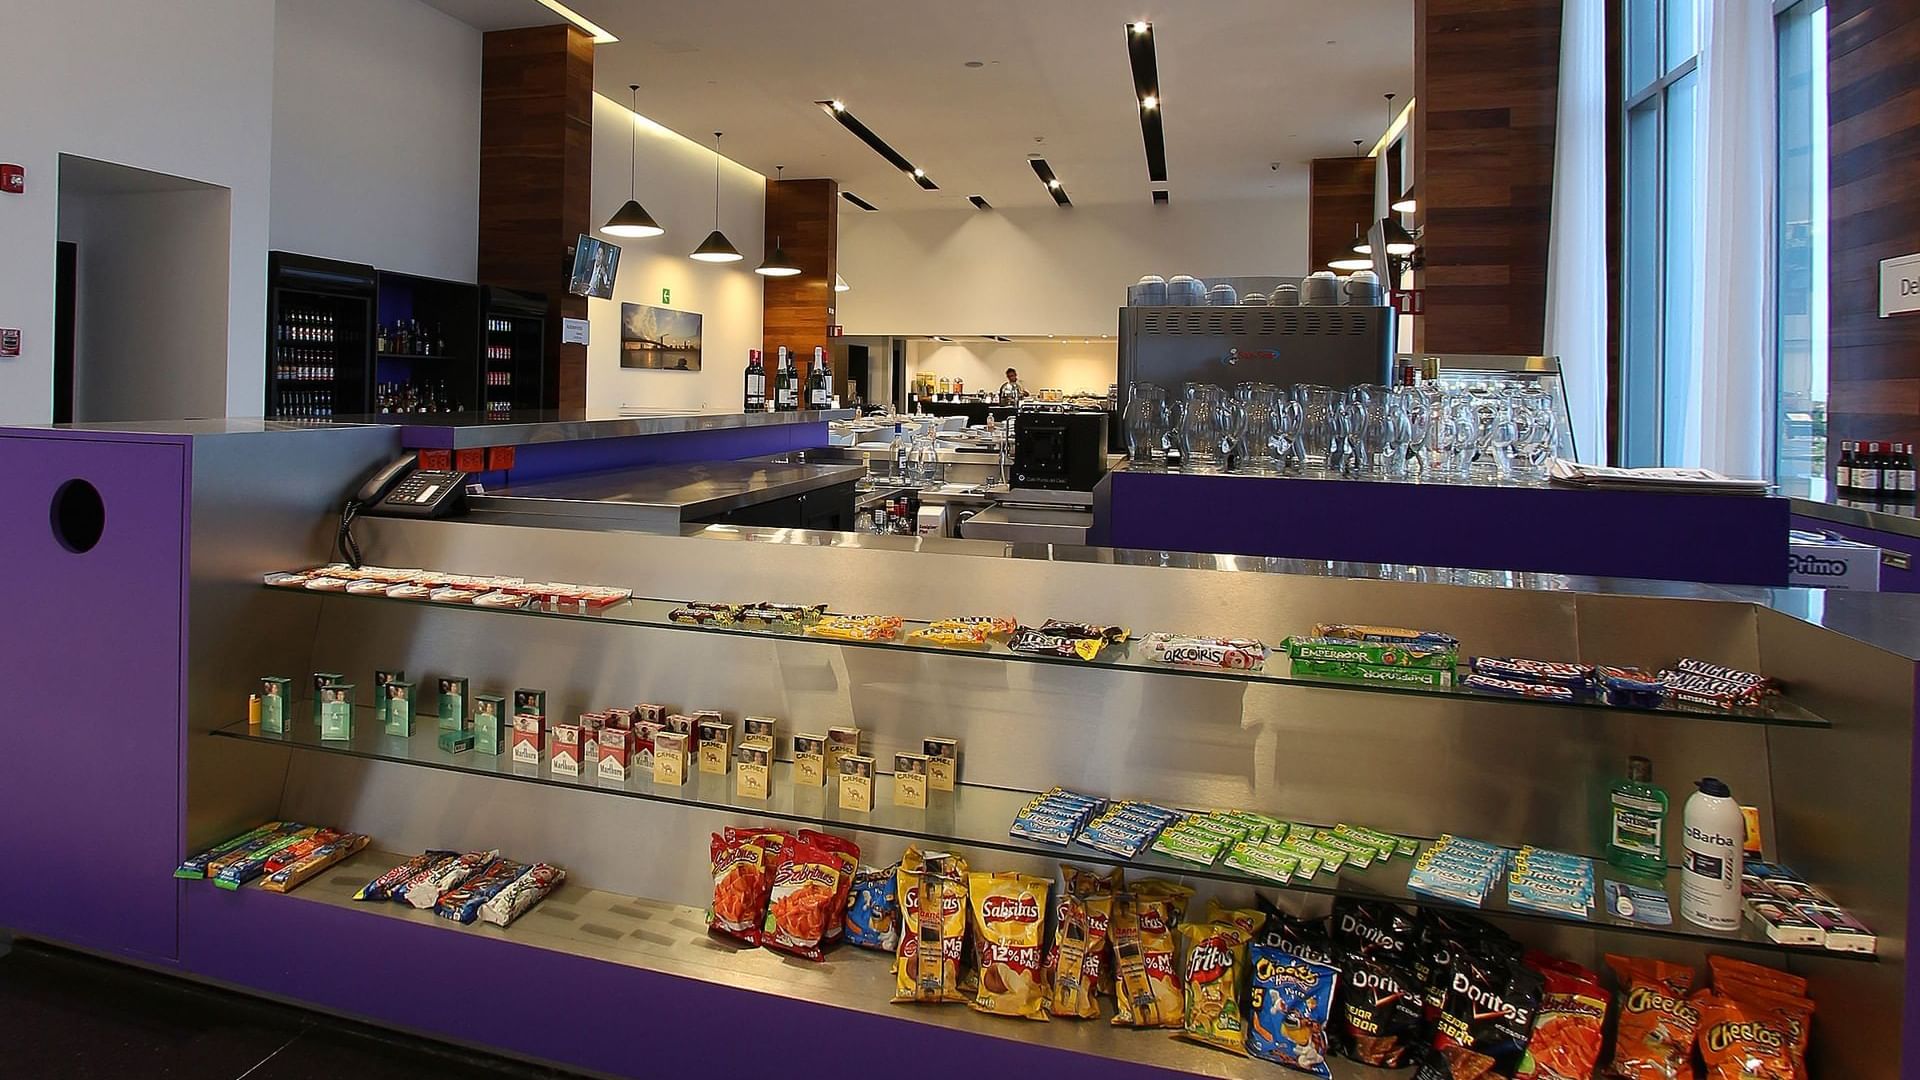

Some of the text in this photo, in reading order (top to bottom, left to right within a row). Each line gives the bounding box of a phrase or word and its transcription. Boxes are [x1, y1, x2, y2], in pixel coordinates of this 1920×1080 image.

[553, 757, 576, 773] Marlboro
[600, 761, 622, 777] Marlboro
[1521, 878, 1577, 896] Trident
[983, 898, 1039, 920] Sabritas
[1341, 914, 1404, 951] Doritos
[1353, 970, 1424, 1008] Doritos
[1452, 972, 1529, 1025] Doritos
[1627, 986, 1699, 1025] Cheetos
[1708, 1022, 1782, 1051] Cheetos
